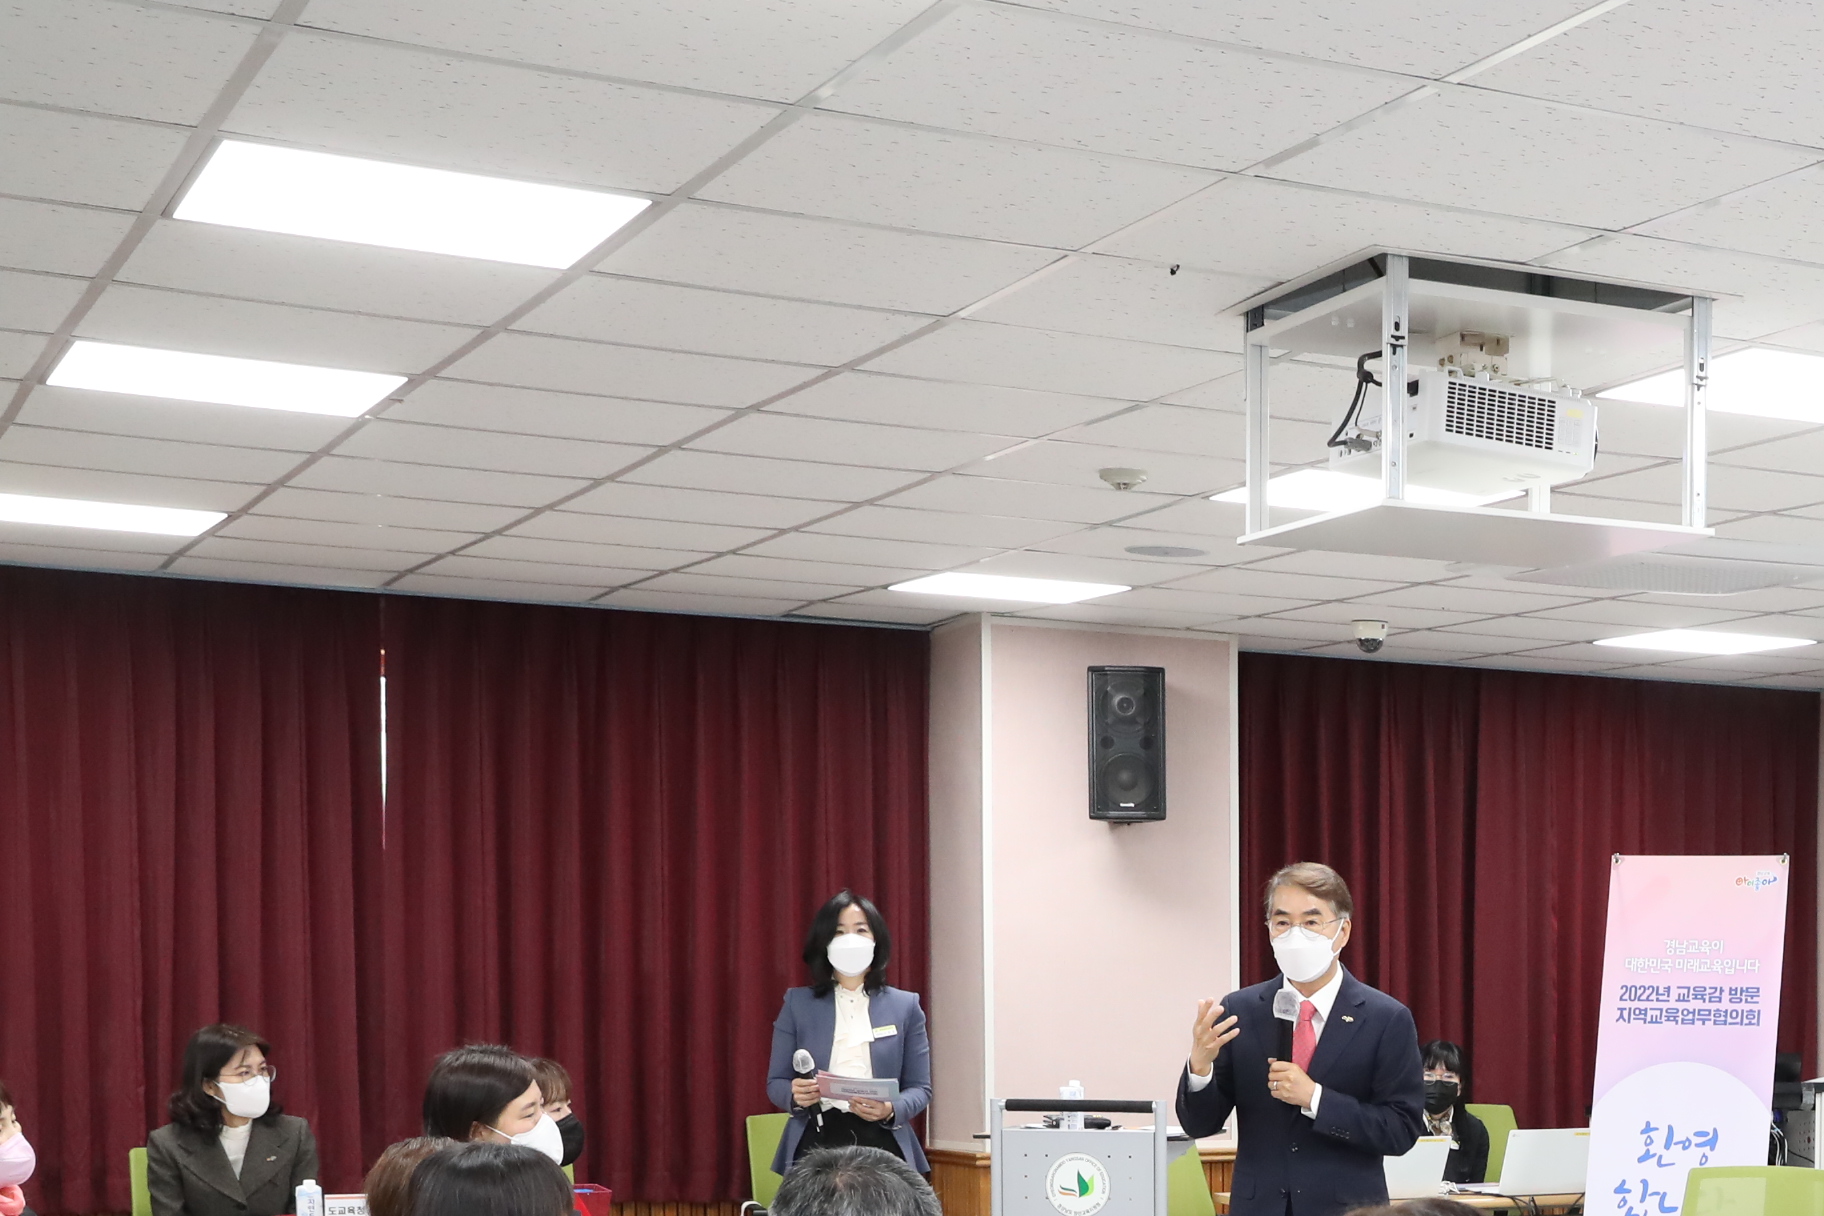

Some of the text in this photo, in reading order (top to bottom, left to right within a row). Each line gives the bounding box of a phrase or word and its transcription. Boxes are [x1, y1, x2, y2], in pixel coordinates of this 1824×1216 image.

[1663, 939, 1724, 955] 경남교육이
[1624, 957, 1760, 975] 대한민국 미래교육입니다
[1619, 984, 1760, 1004] 2022년 교육감 방문
[1615, 1006, 1761, 1027] 지역교육업무협의회
[1637, 1120, 1719, 1168] 환영
